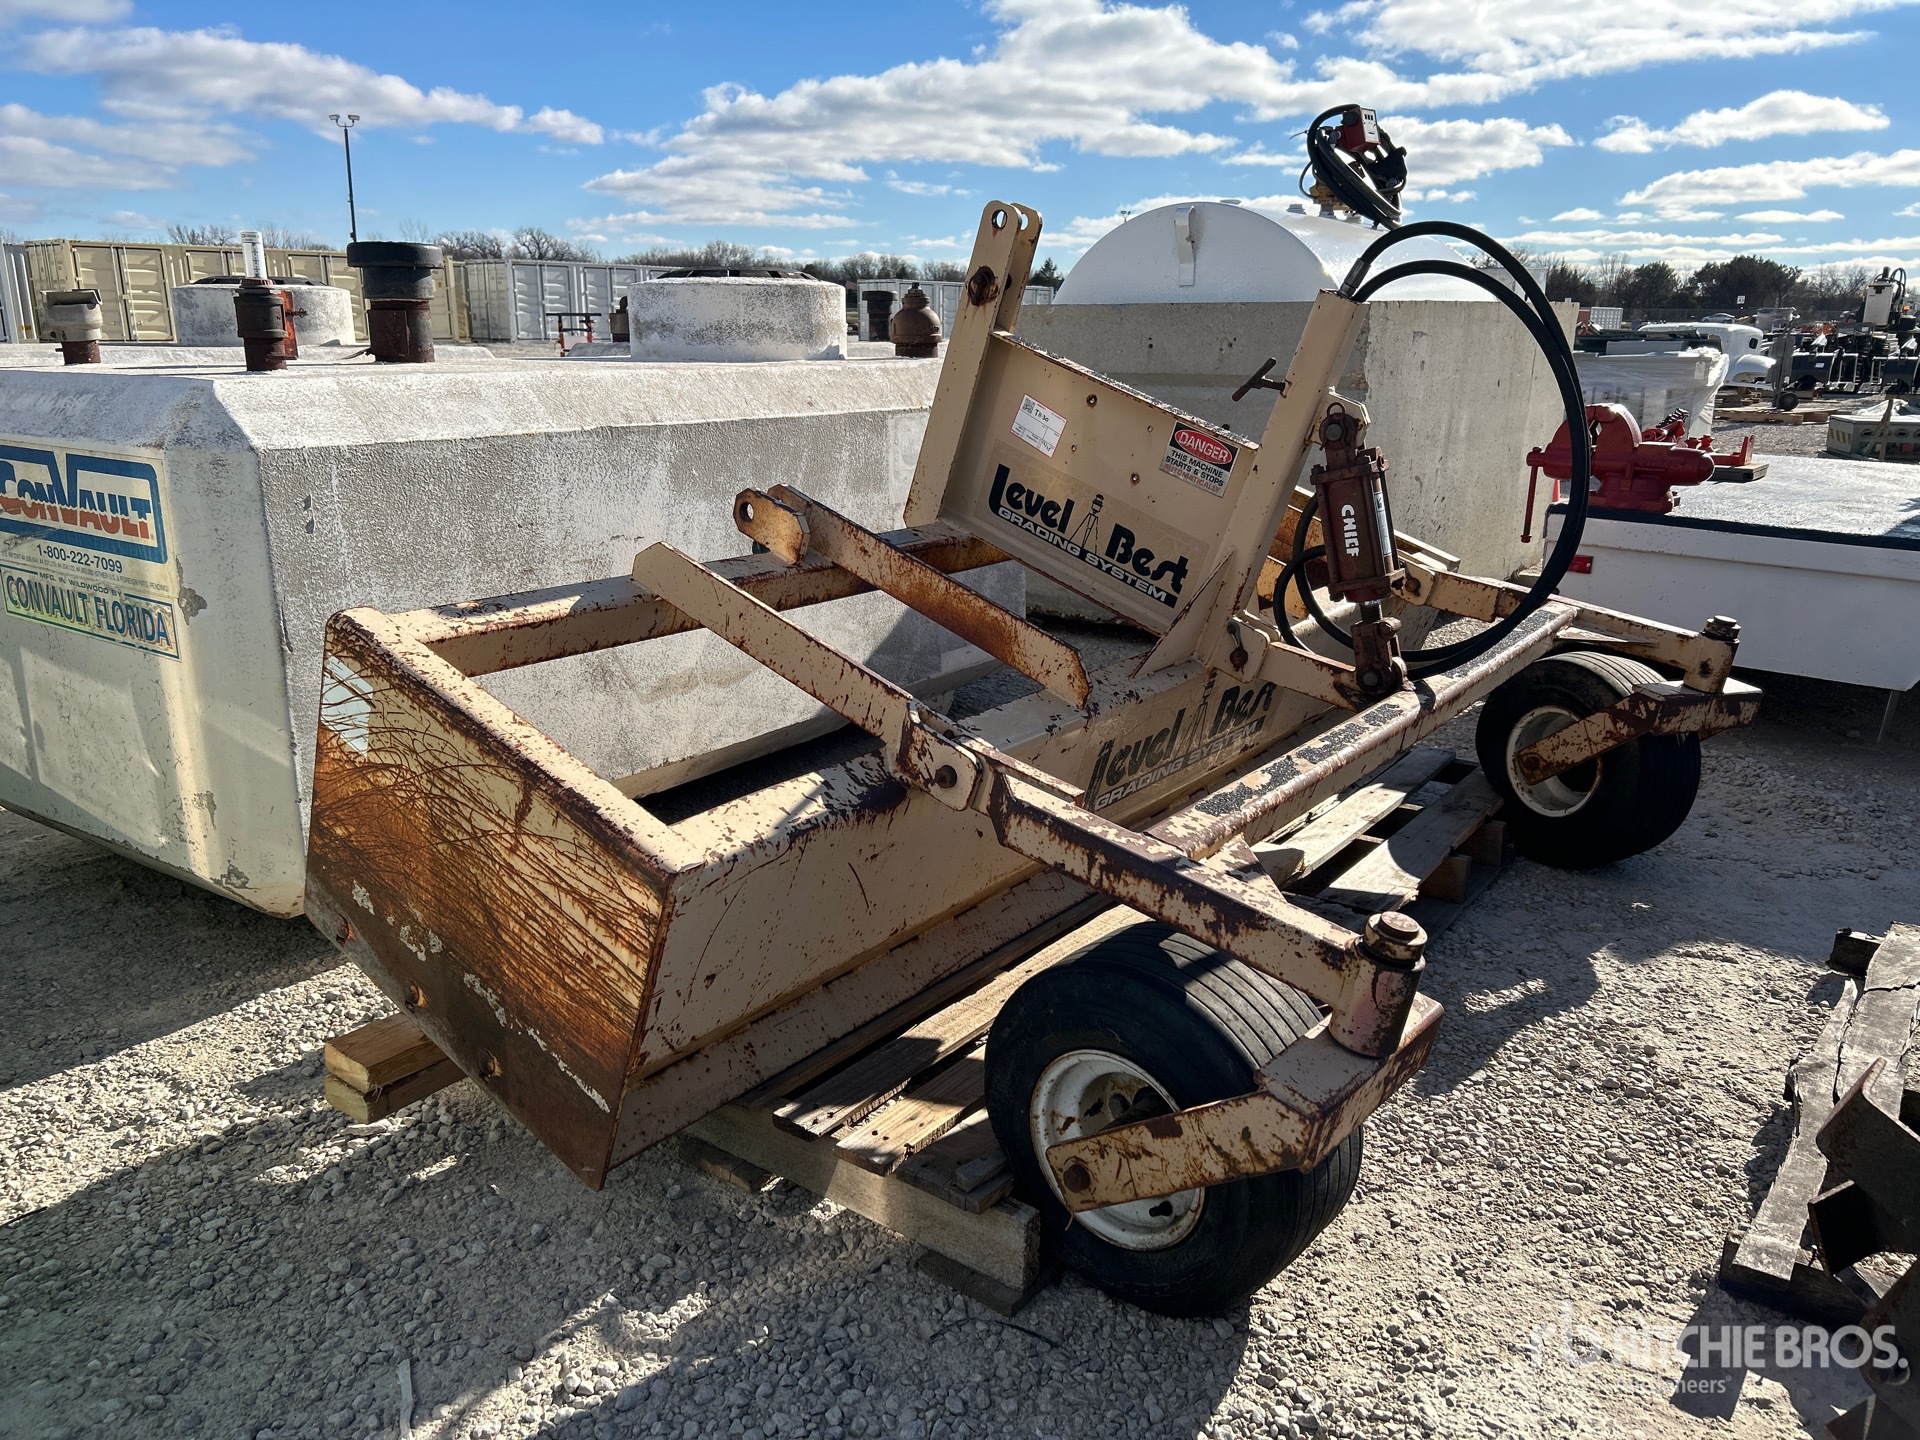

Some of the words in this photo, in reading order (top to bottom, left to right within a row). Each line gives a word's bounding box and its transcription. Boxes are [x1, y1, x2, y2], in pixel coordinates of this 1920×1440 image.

[1171, 449, 1188, 462] THIS
[1188, 458, 1224, 479] MACHINE
[1178, 431, 1229, 463] DANGER
[1164, 463, 1222, 493] AUTOMATICALLY
[1165, 455, 1192, 472] STARTS
[1200, 472, 1224, 487] STOPS
[0, 459, 152, 539] CONVAULT
[988, 463, 1075, 534] Level
[1104, 523, 1189, 595] Best
[1341, 504, 1360, 558] CHIEF
[36, 543, 123, 574] 1-800-222-7099
[997, 506, 1081, 557] GRADING
[1084, 552, 1167, 602] SYSTEM
[39, 572, 57, 582] MFG.
[68, 579, 109, 594] WILDWOOD
[111, 589, 122, 597] BY
[6, 575, 89, 626] CONVAULT
[93, 597, 172, 648] FLORIDA
[1094, 758, 1185, 812] GRADING
[1187, 720, 1258, 766] SYSTEM
